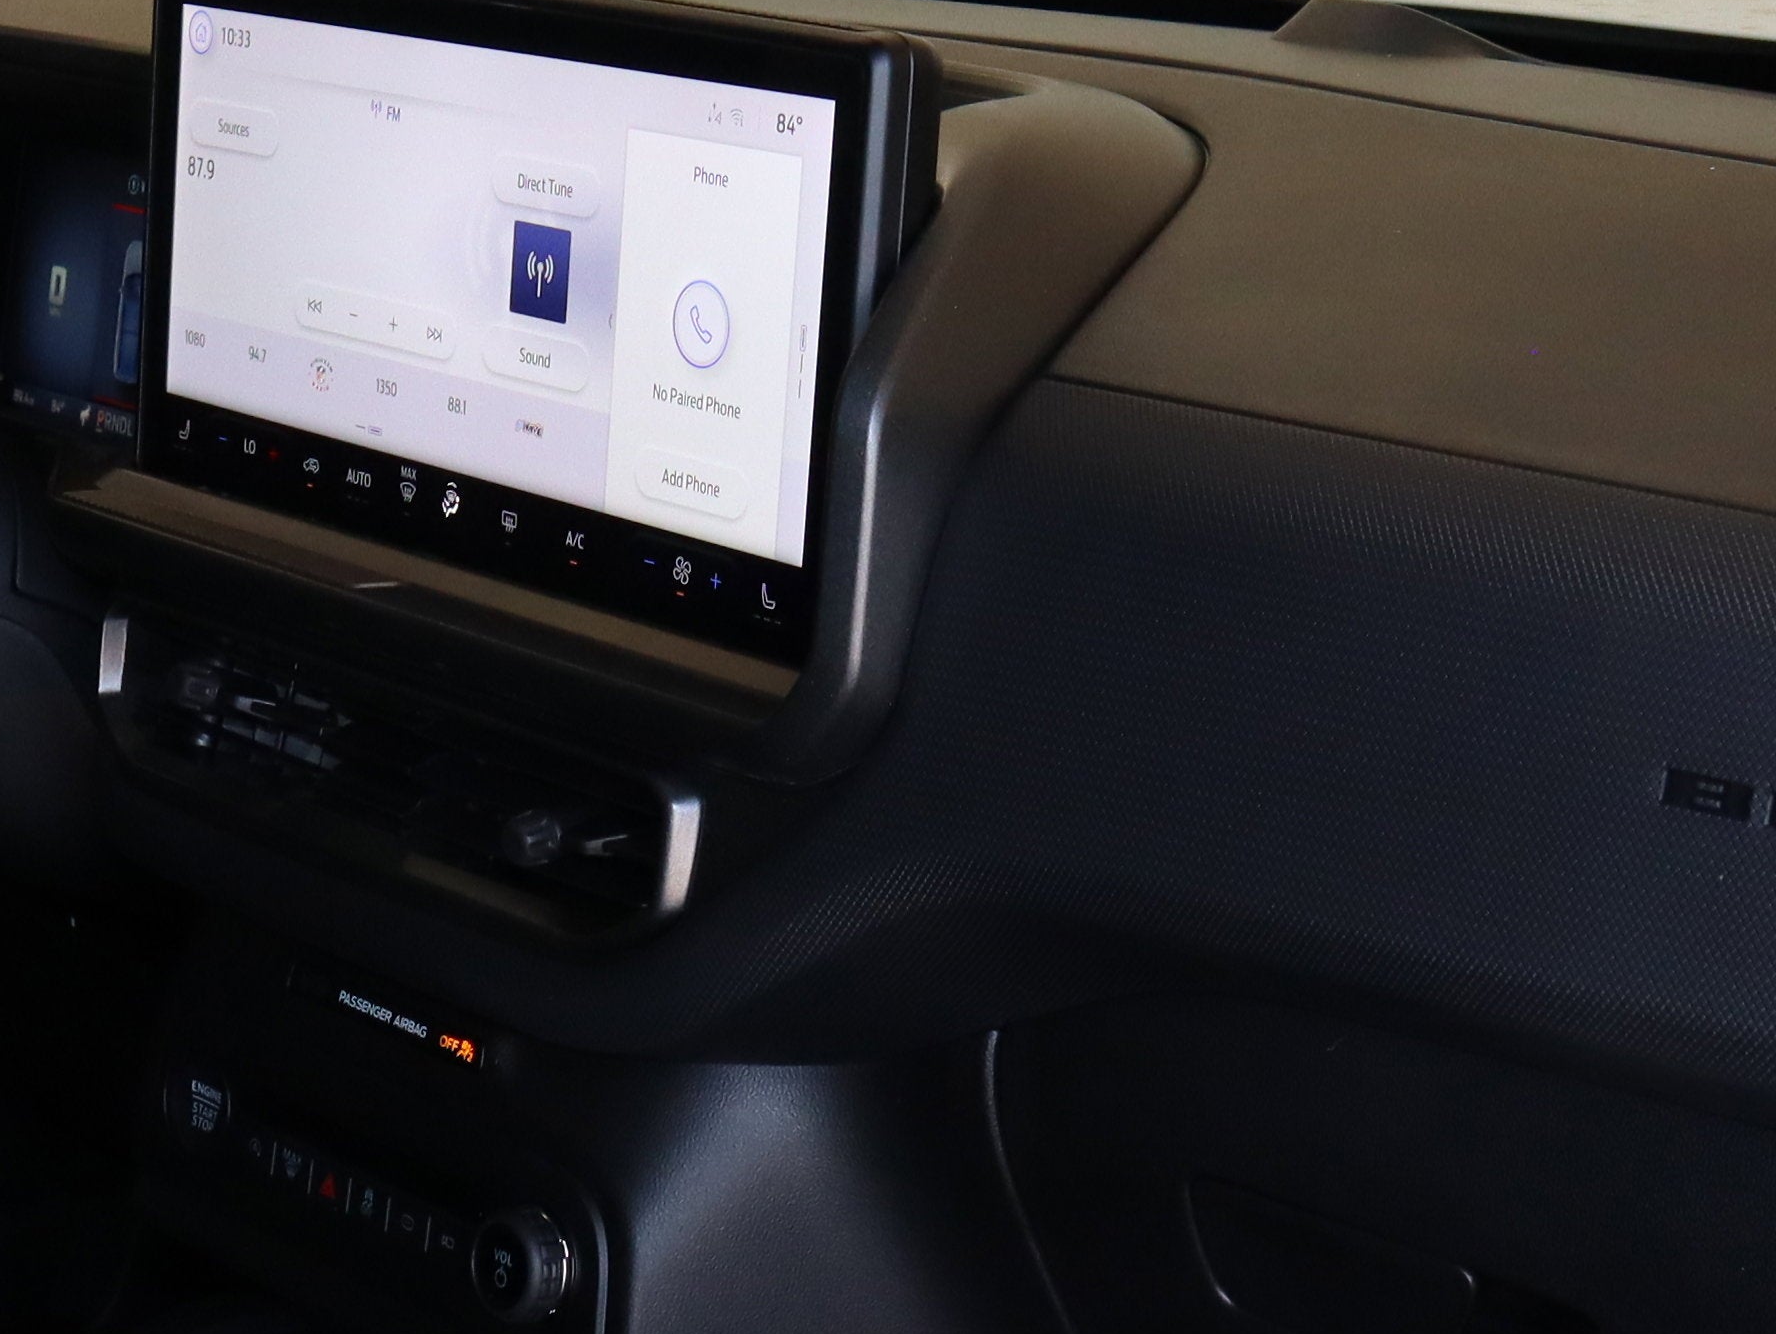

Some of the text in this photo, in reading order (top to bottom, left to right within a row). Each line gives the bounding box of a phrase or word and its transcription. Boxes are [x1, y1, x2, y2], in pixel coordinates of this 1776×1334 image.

[221, 26, 251, 49] 10:33
[386, 106, 401, 122] FM
[776, 112, 803, 136] 84°
[217, 118, 250, 138] Sources
[187, 155, 215, 180] 87.9
[692, 165, 729, 189] Phone
[517, 172, 573, 199] Direct Tune
[184, 328, 206, 349] 1080
[518, 346, 551, 369] Sound
[375, 378, 398, 398] 1350
[446, 395, 467, 416] 88.1
[652, 383, 741, 419] No Paired Phone
[243, 437, 257, 456] LO
[345, 467, 373, 489] AUTO
[400, 464, 418, 482] MAX
[661, 468, 721, 498] Add Phone
[565, 530, 585, 551] A/C
[337, 989, 460, 1053] PASSENGER AIRBAG OFF
[190, 1079, 223, 1103] ENGINE
[494, 1247, 513, 1268] VOL
